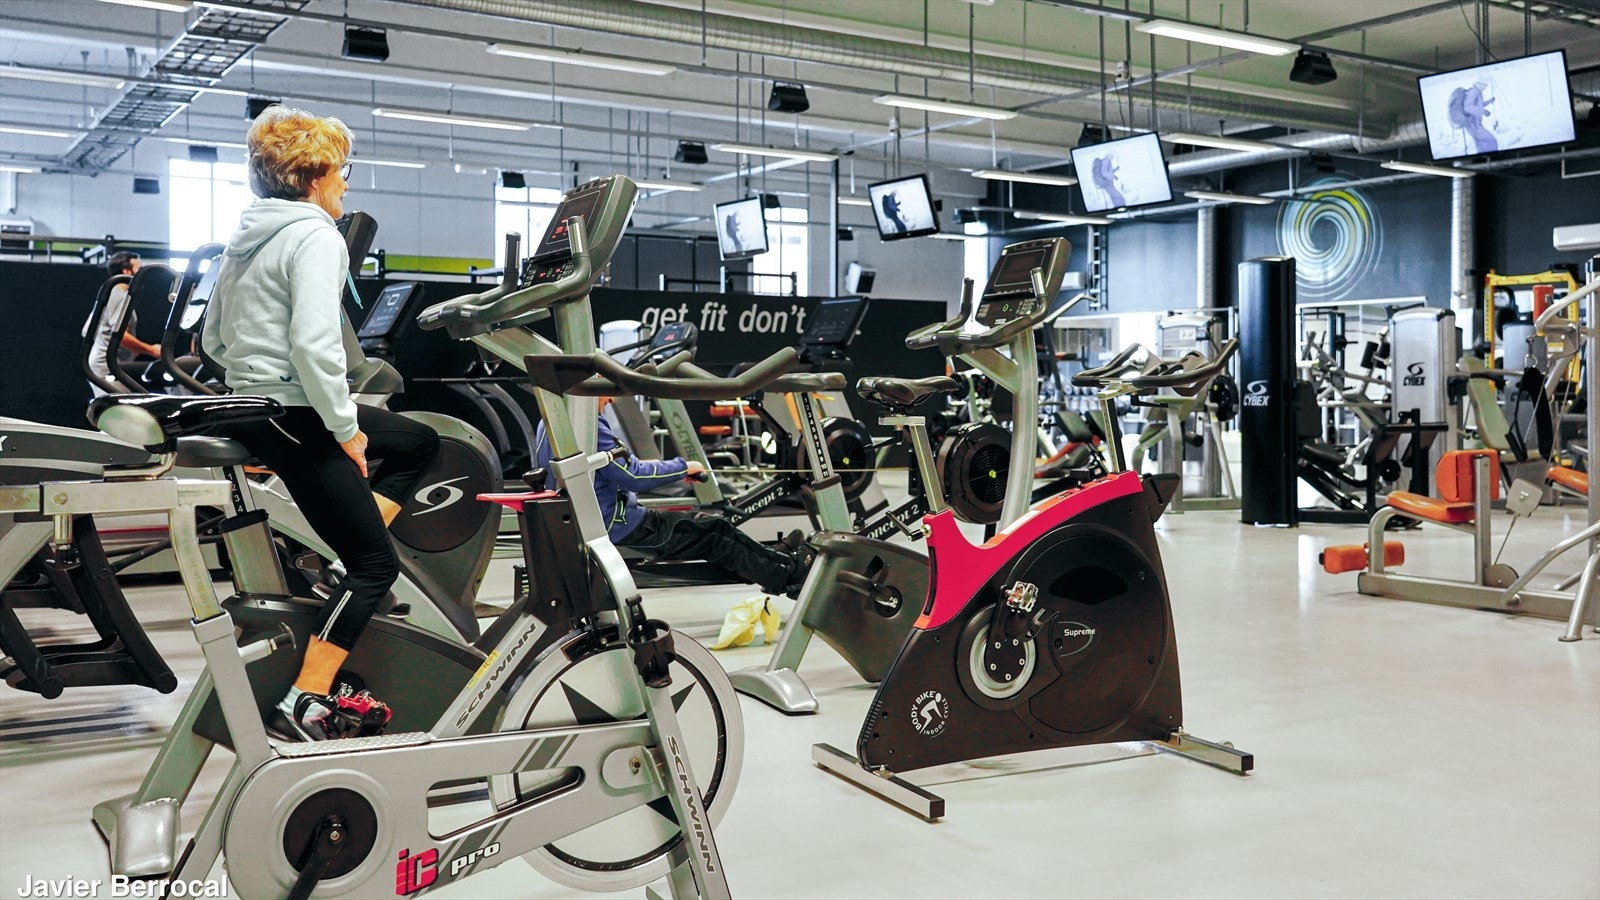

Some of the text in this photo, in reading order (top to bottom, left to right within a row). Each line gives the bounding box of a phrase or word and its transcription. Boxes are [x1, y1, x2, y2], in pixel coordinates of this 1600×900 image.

[642, 301, 807, 336] get fit don't
[1243, 395, 1269, 407] CYBEX
[676, 430, 701, 461] CYBE
[231, 483, 237, 492] 2
[233, 494, 240, 502] 3
[776, 486, 785, 497] 2
[911, 504, 920, 515] 2
[456, 622, 537, 729] SCHWINN
[911, 690, 937, 731] BODY BIKE
[923, 720, 946, 735] INDOOR
[667, 734, 716, 873] SCHWINN
[450, 842, 501, 877] pro
